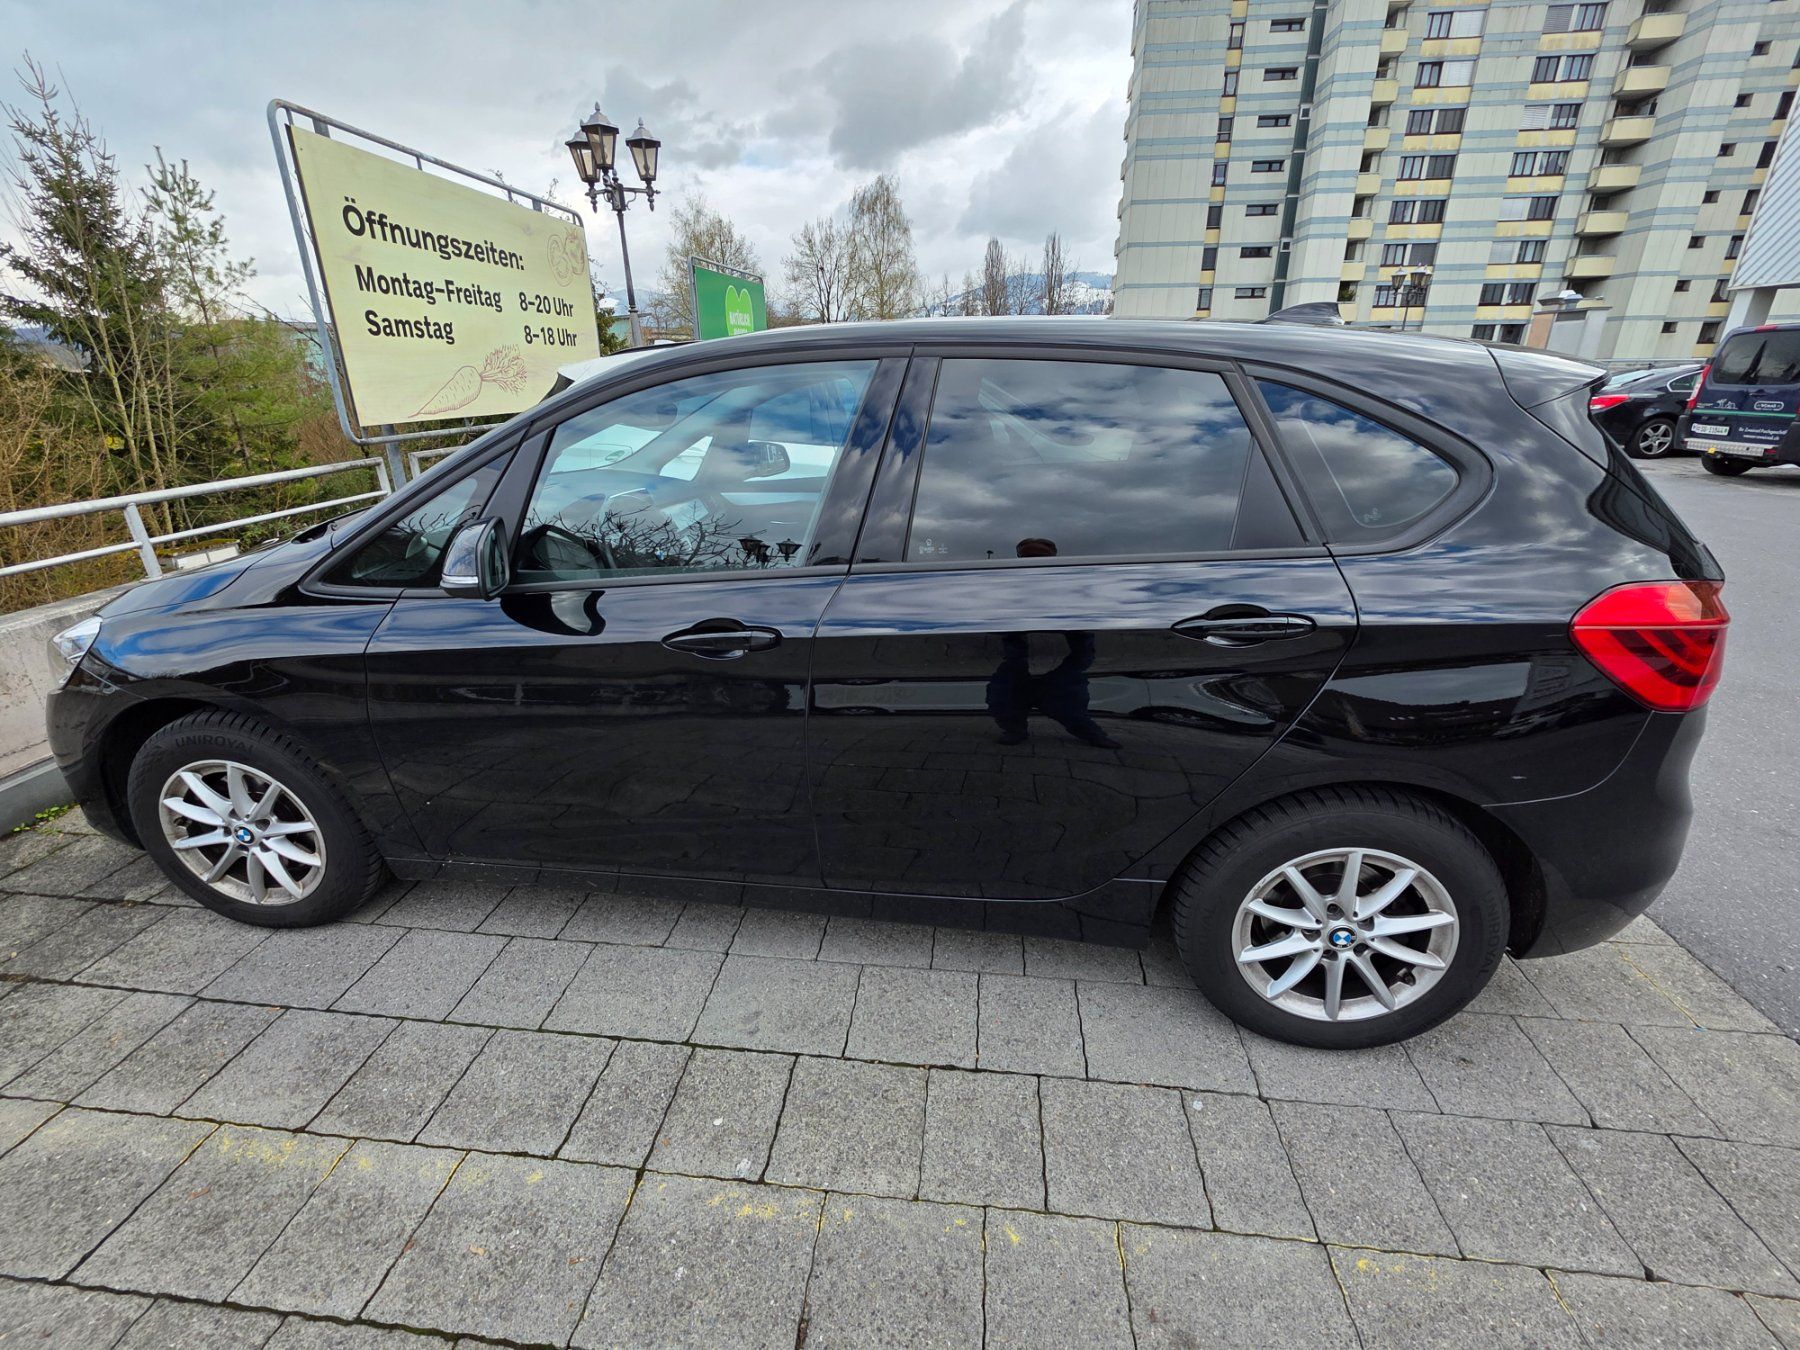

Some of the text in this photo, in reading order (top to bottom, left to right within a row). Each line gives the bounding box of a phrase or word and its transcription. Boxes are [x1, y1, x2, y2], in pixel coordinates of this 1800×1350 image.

[342, 196, 525, 271] Öffnungszeiten:
[553, 297, 574, 318] Uhr
[364, 309, 455, 345] Samstag
[557, 328, 577, 347] Uhr
